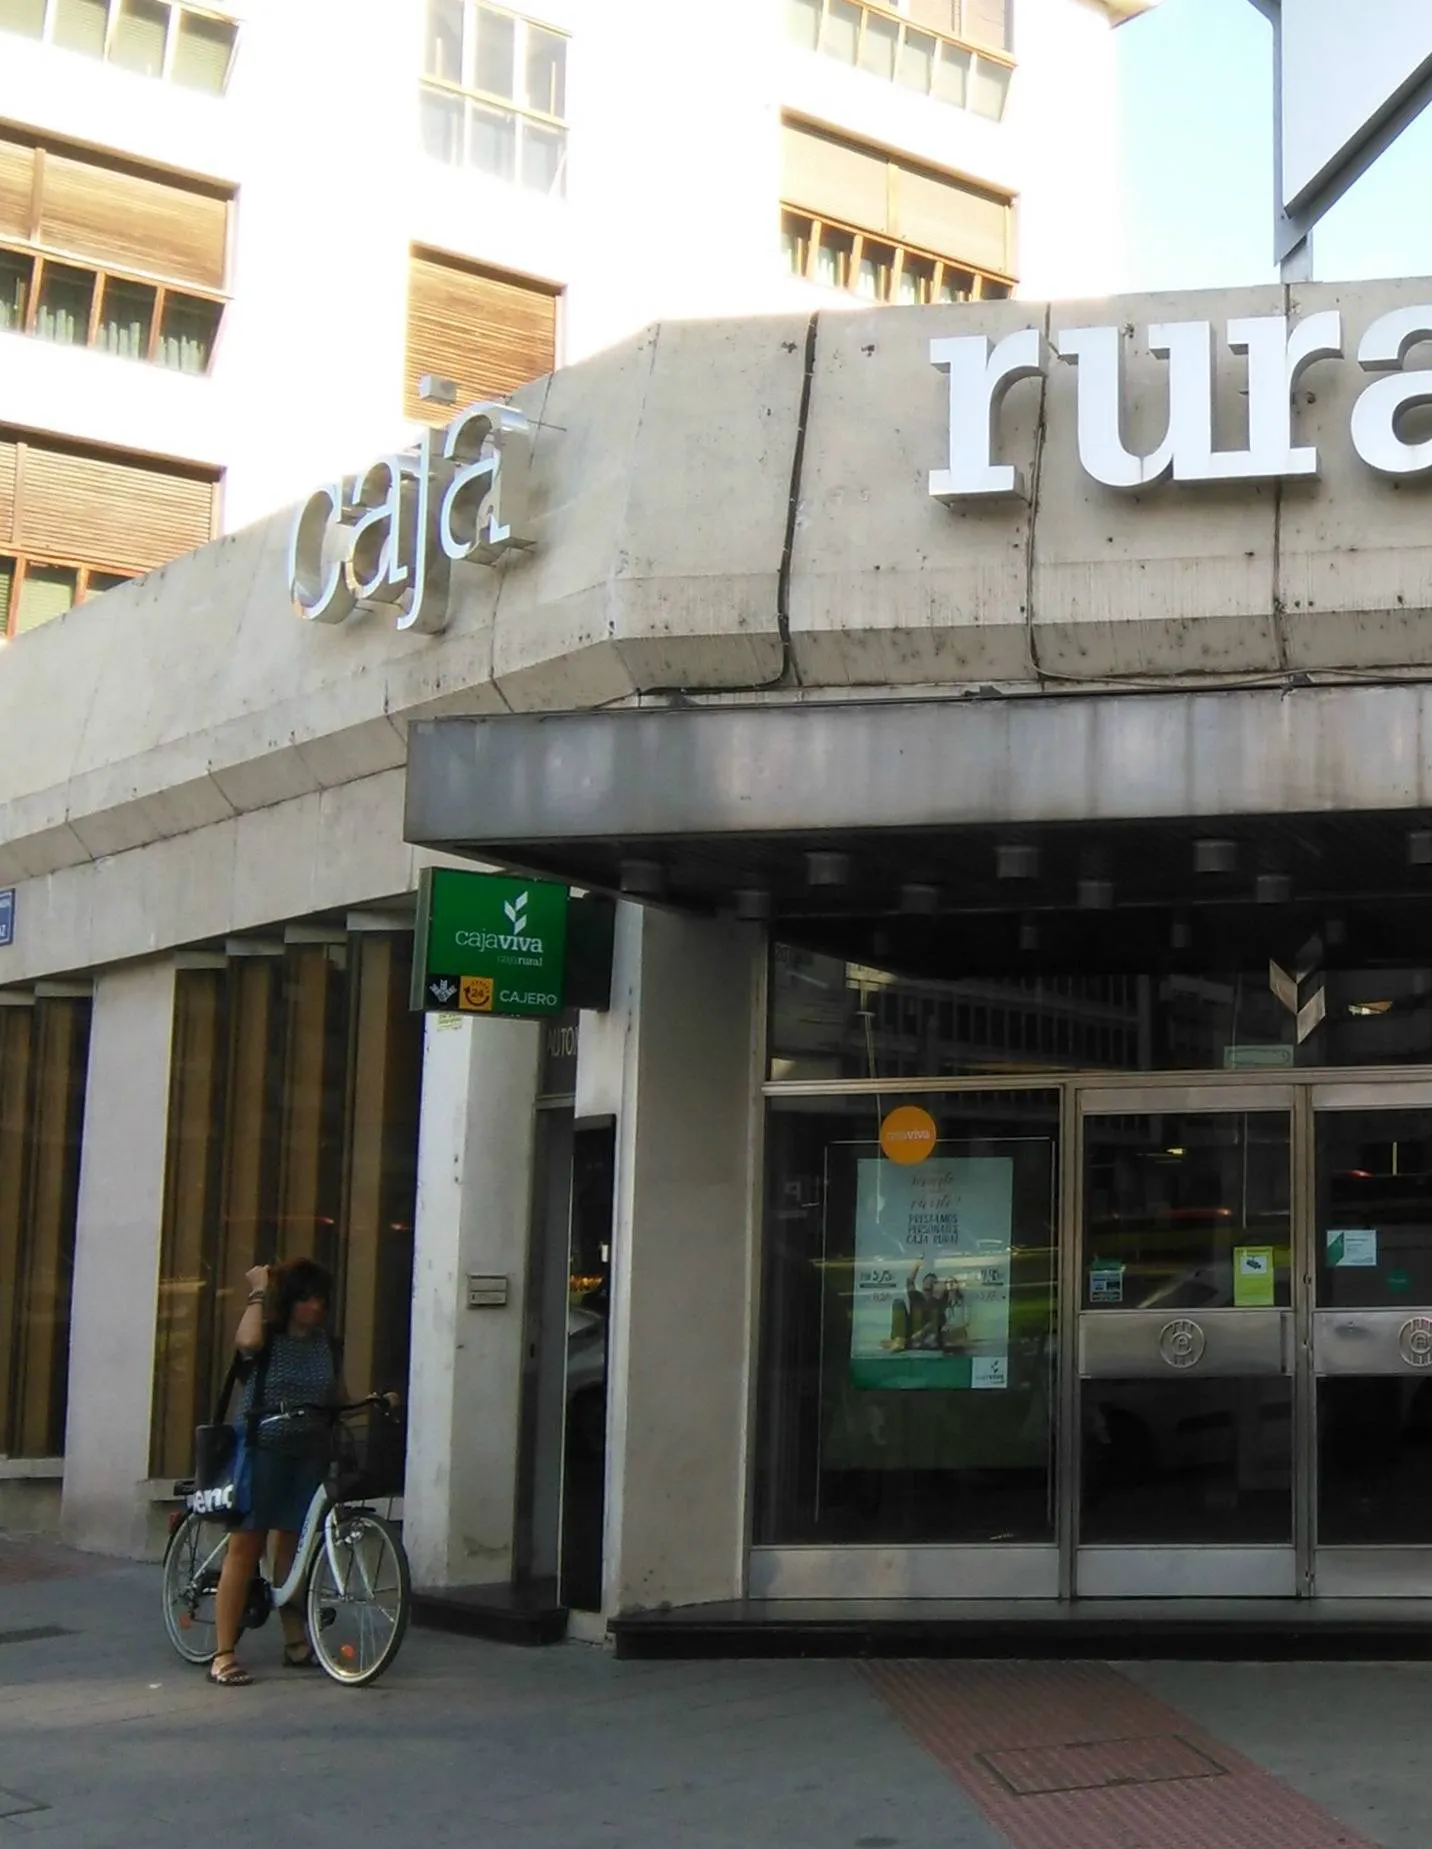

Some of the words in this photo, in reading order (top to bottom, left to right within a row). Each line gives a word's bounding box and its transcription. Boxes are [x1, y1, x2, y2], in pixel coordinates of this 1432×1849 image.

[288, 401, 513, 631] caja
[455, 928, 543, 953] cajaviva
[499, 989, 558, 1006] CAJERO
